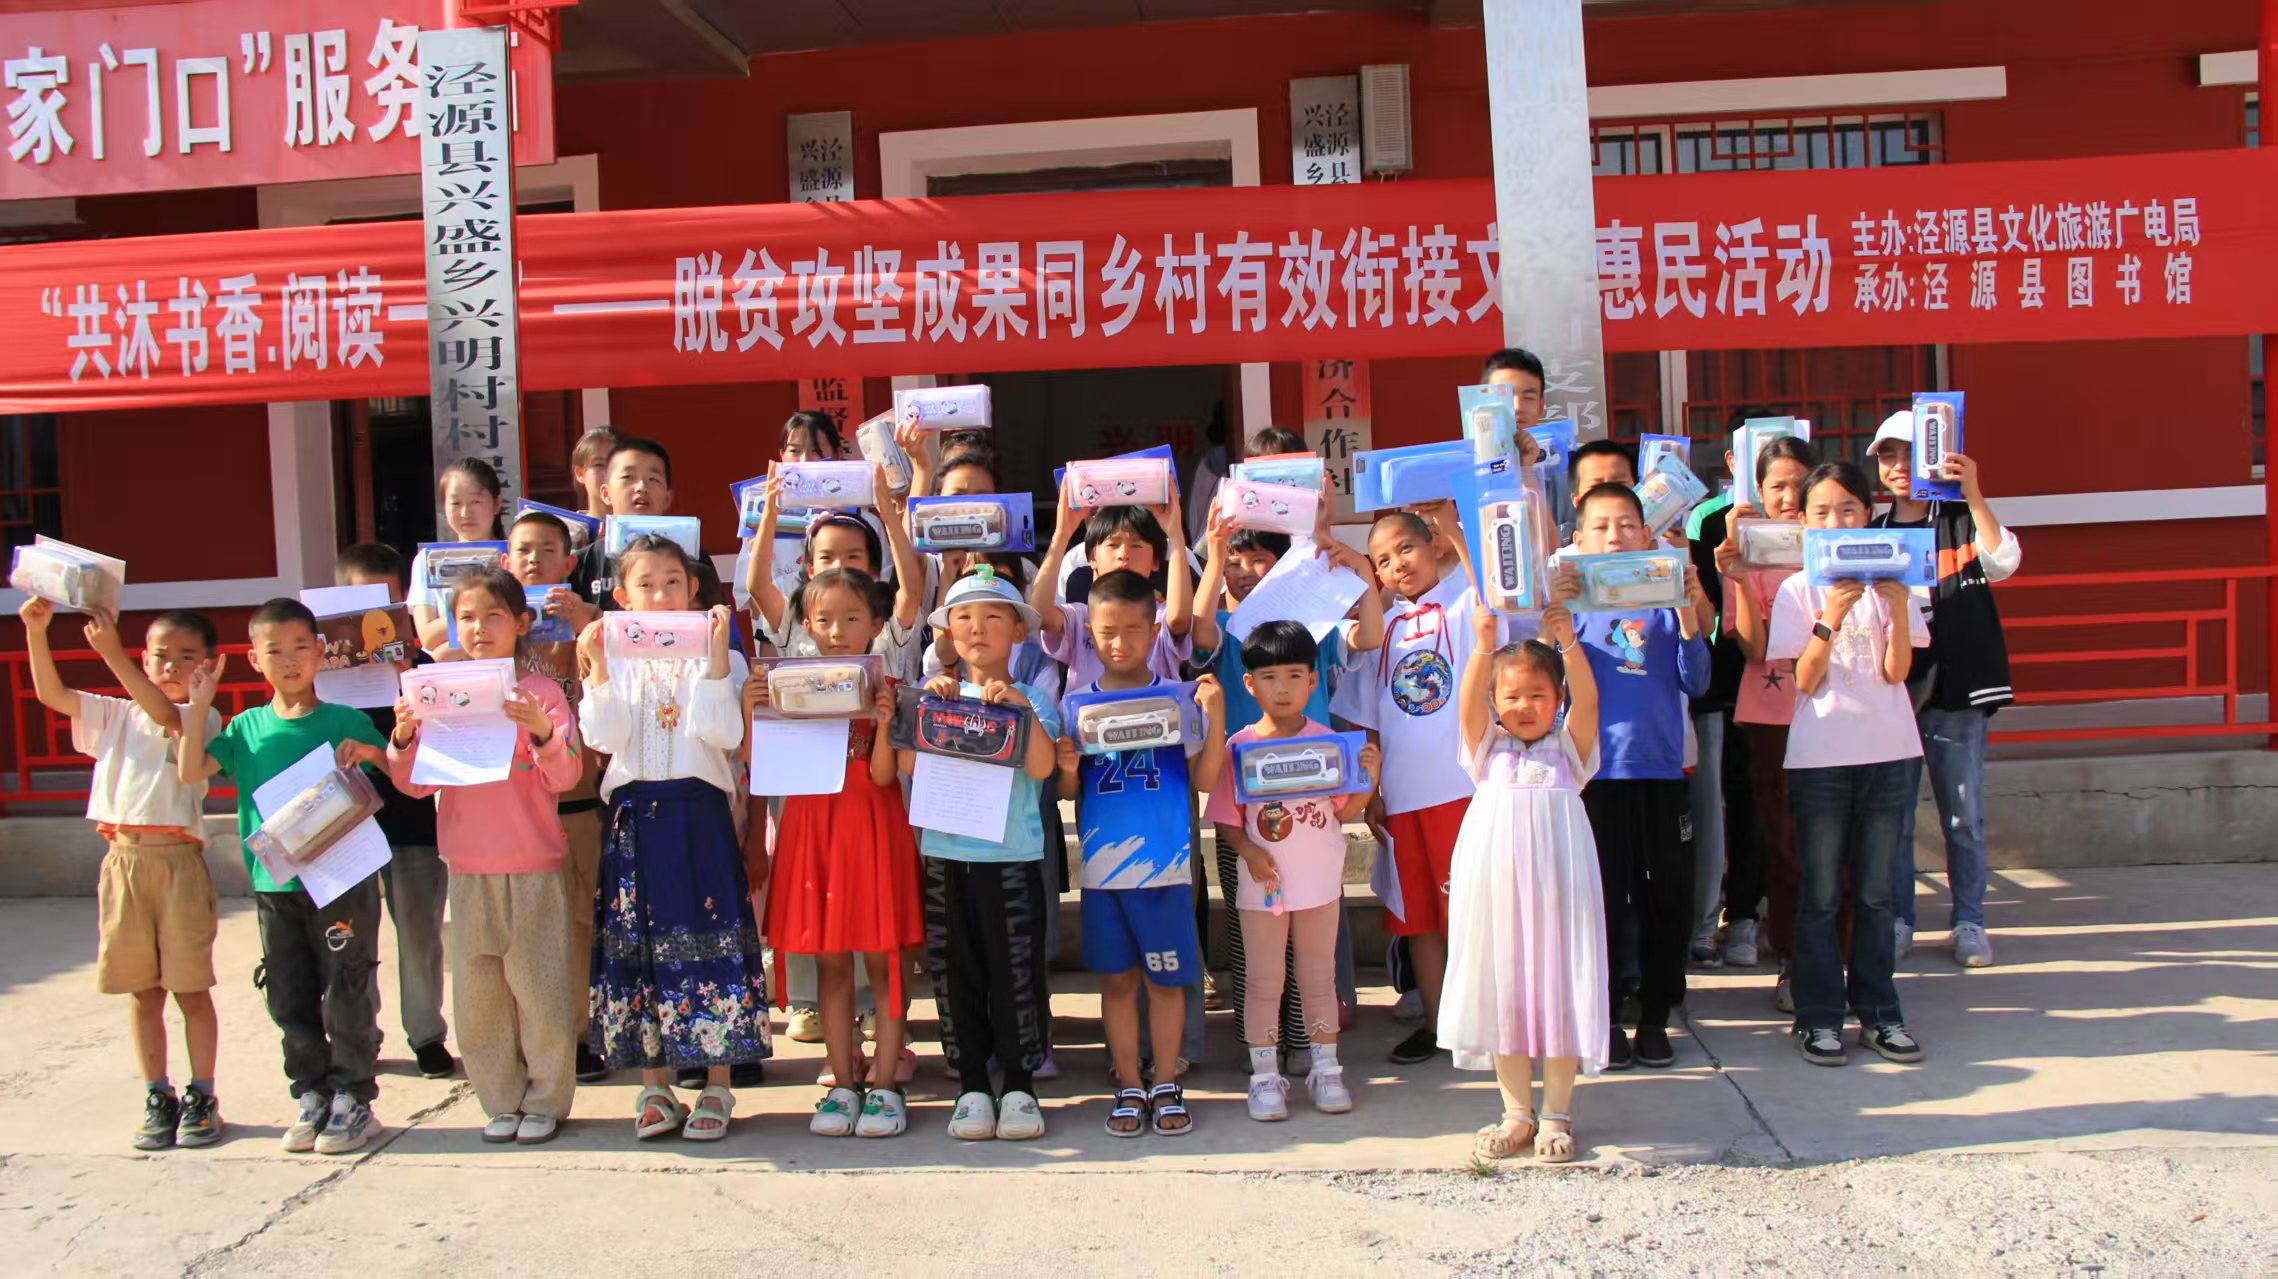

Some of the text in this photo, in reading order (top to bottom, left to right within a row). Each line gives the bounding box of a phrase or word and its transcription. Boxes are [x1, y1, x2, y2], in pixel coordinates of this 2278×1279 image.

[3, 18, 519, 165] 家门口”服务
[800, 139, 820, 203] 兴盛
[820, 138, 843, 202] 泾源
[423, 61, 511, 516] 泾源县兴盛乡兴明村村
[1499, 525, 1515, 589] WAITING
[1095, 748, 1161, 795] 24
[1145, 950, 1180, 973] 65
